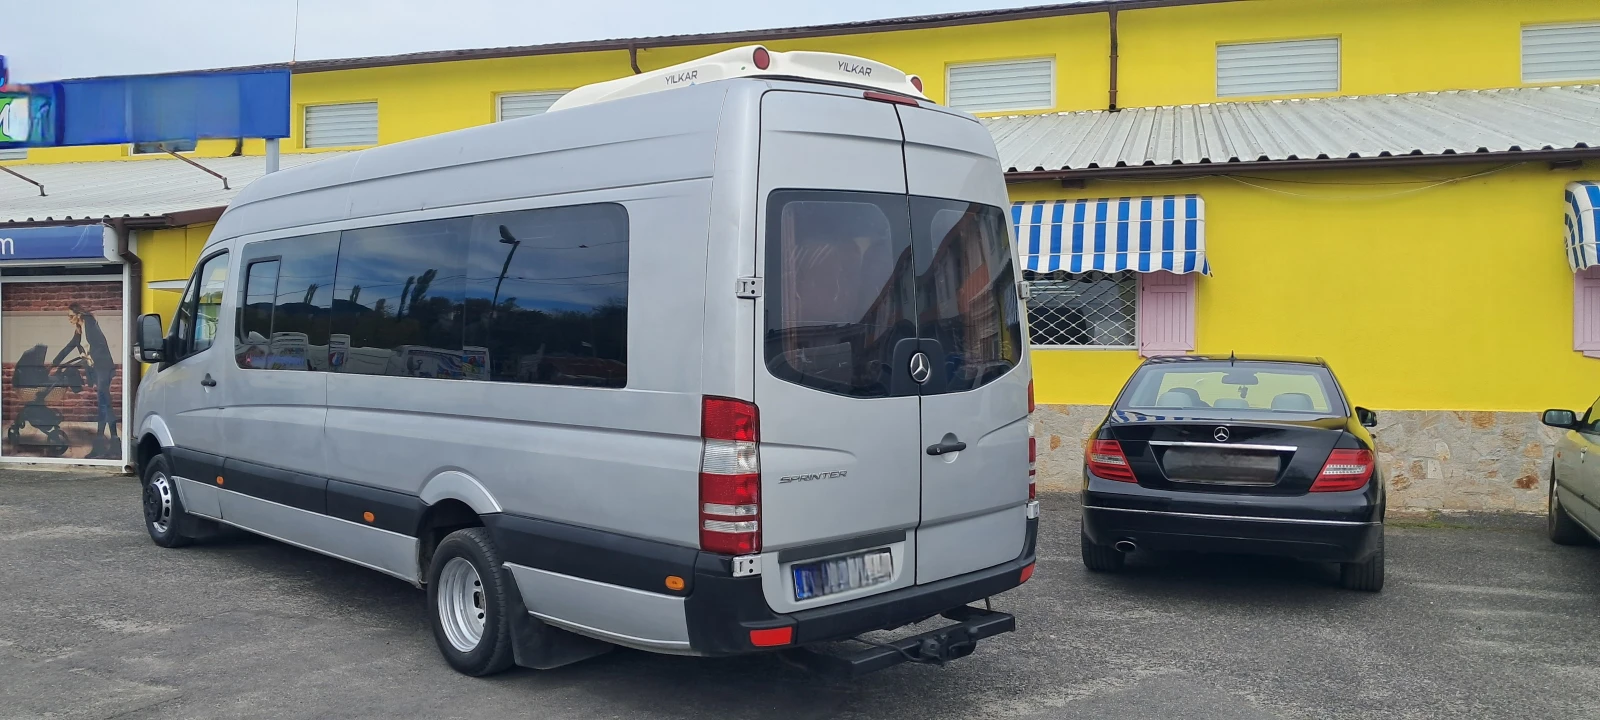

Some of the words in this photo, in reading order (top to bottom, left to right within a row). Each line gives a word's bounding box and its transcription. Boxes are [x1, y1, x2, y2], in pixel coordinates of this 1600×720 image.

[838, 60, 872, 77] YILKAR
[665, 70, 698, 85] YILKAR
[778, 469, 848, 485] SPRINTER
